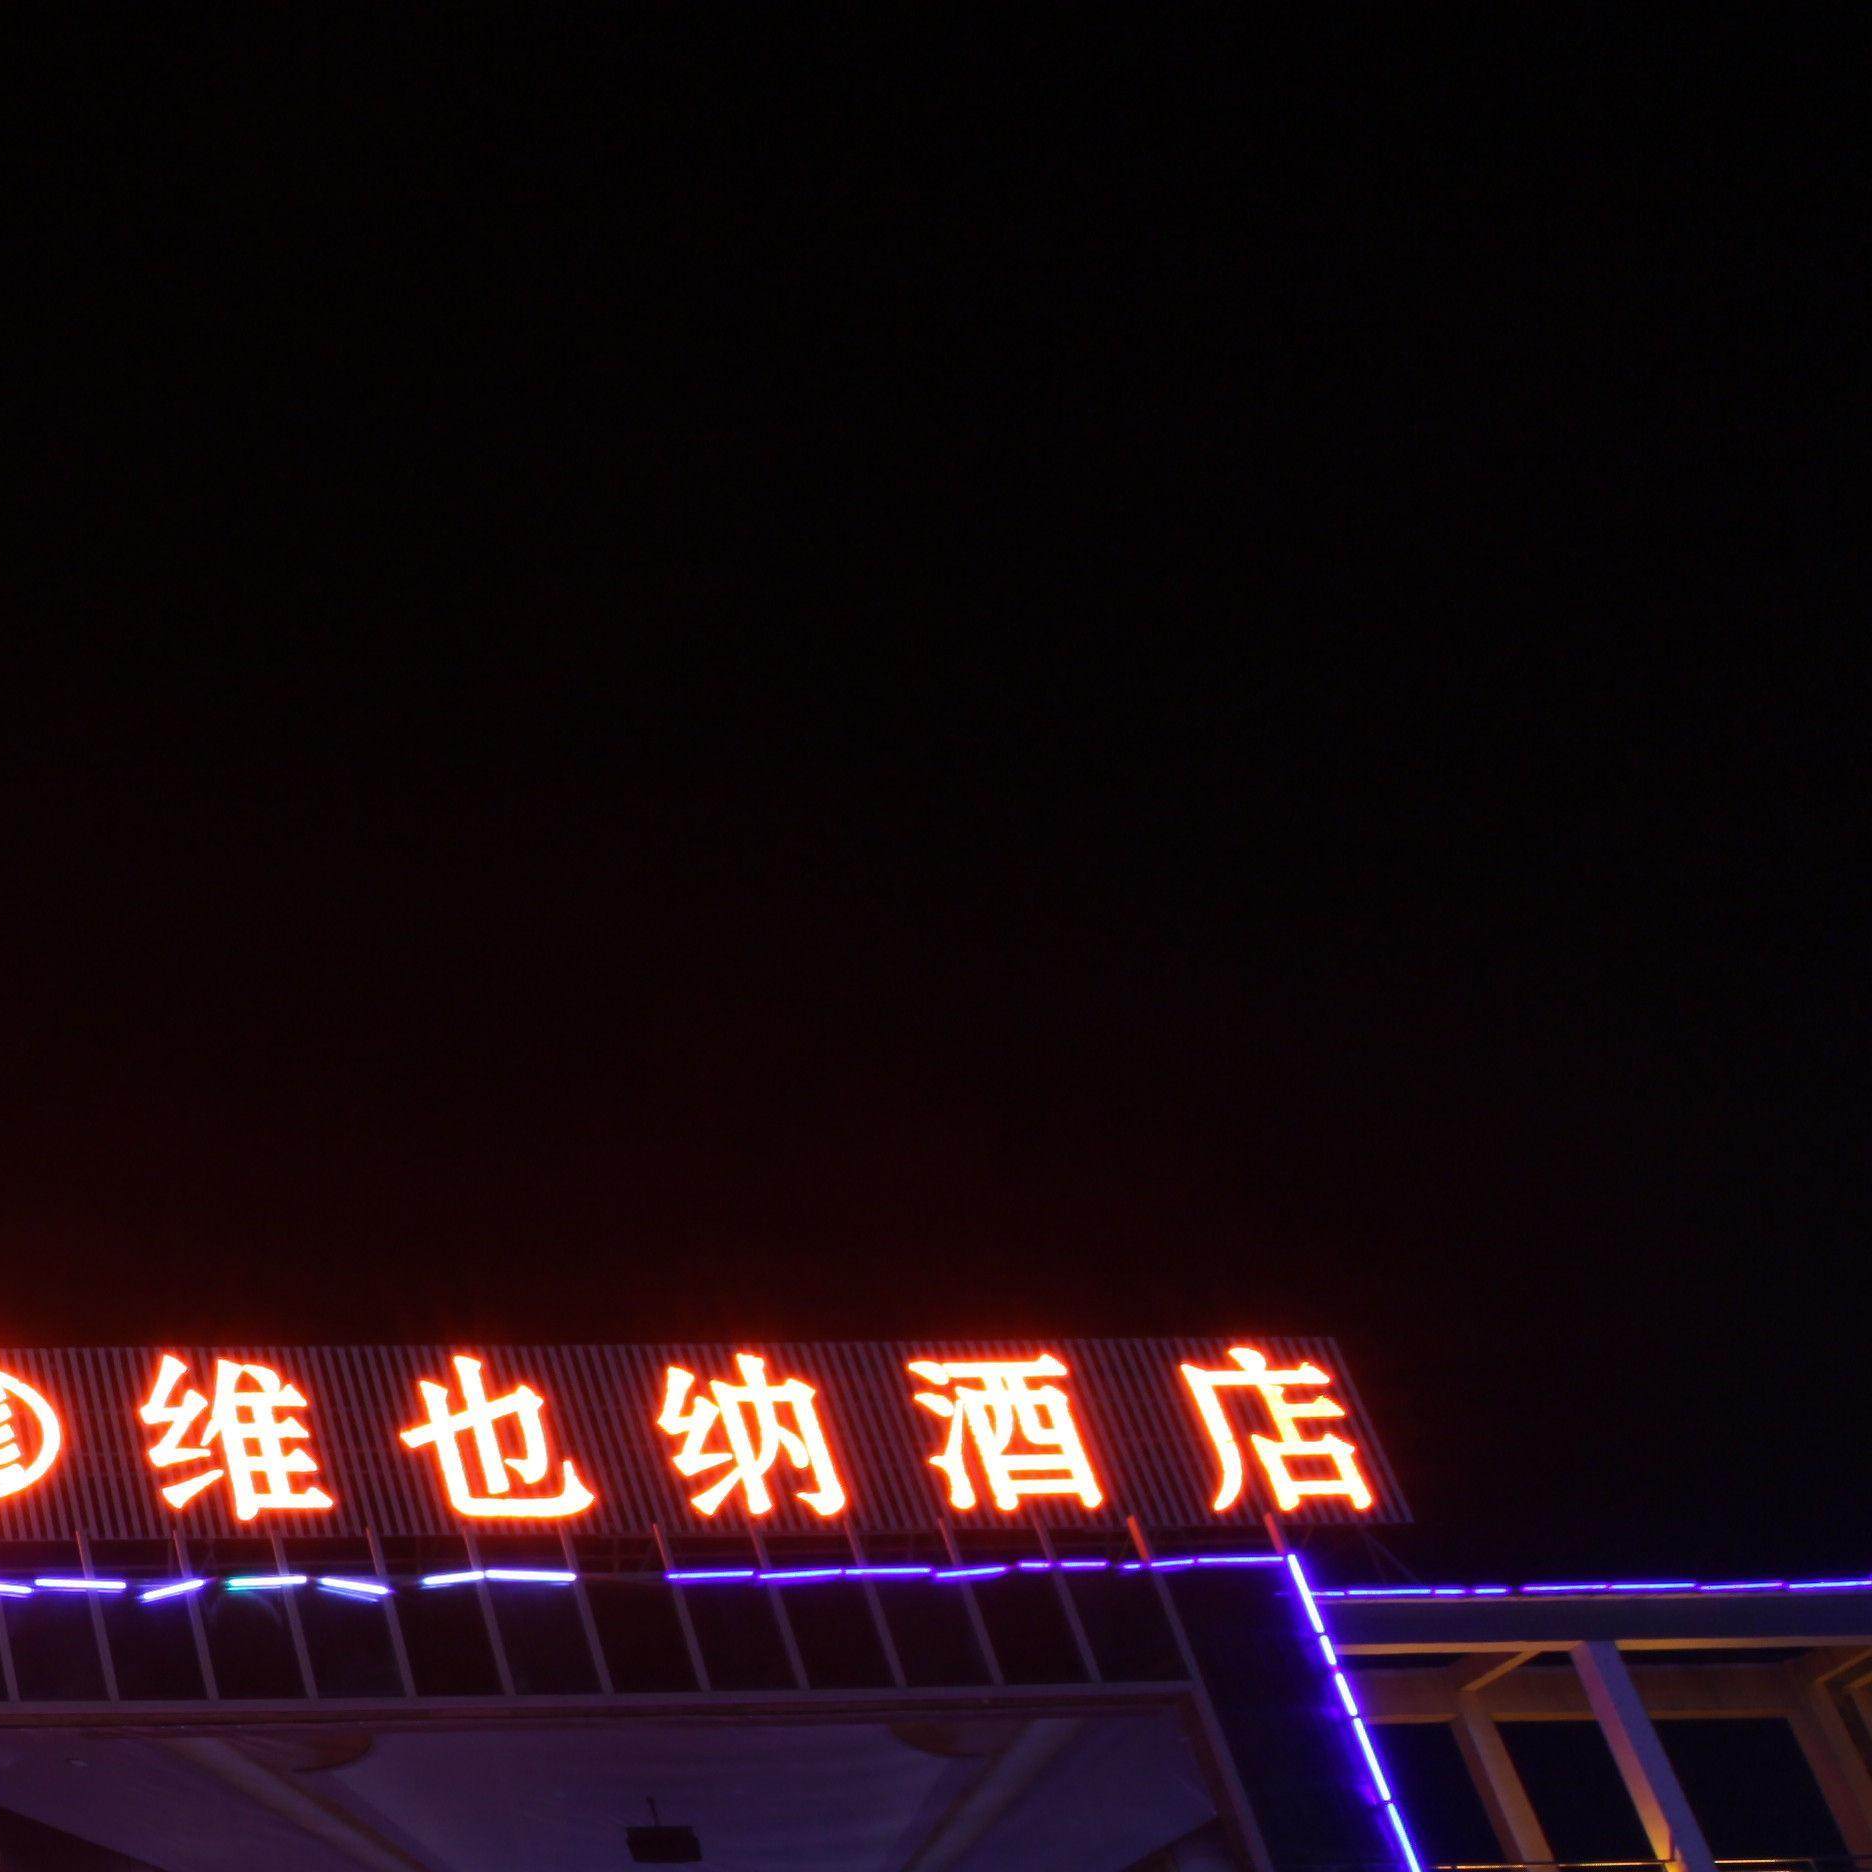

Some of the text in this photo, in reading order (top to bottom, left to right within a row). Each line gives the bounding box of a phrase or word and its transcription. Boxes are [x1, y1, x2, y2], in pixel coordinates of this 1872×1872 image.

[141, 1345, 1374, 1518] 维也纳酒店
